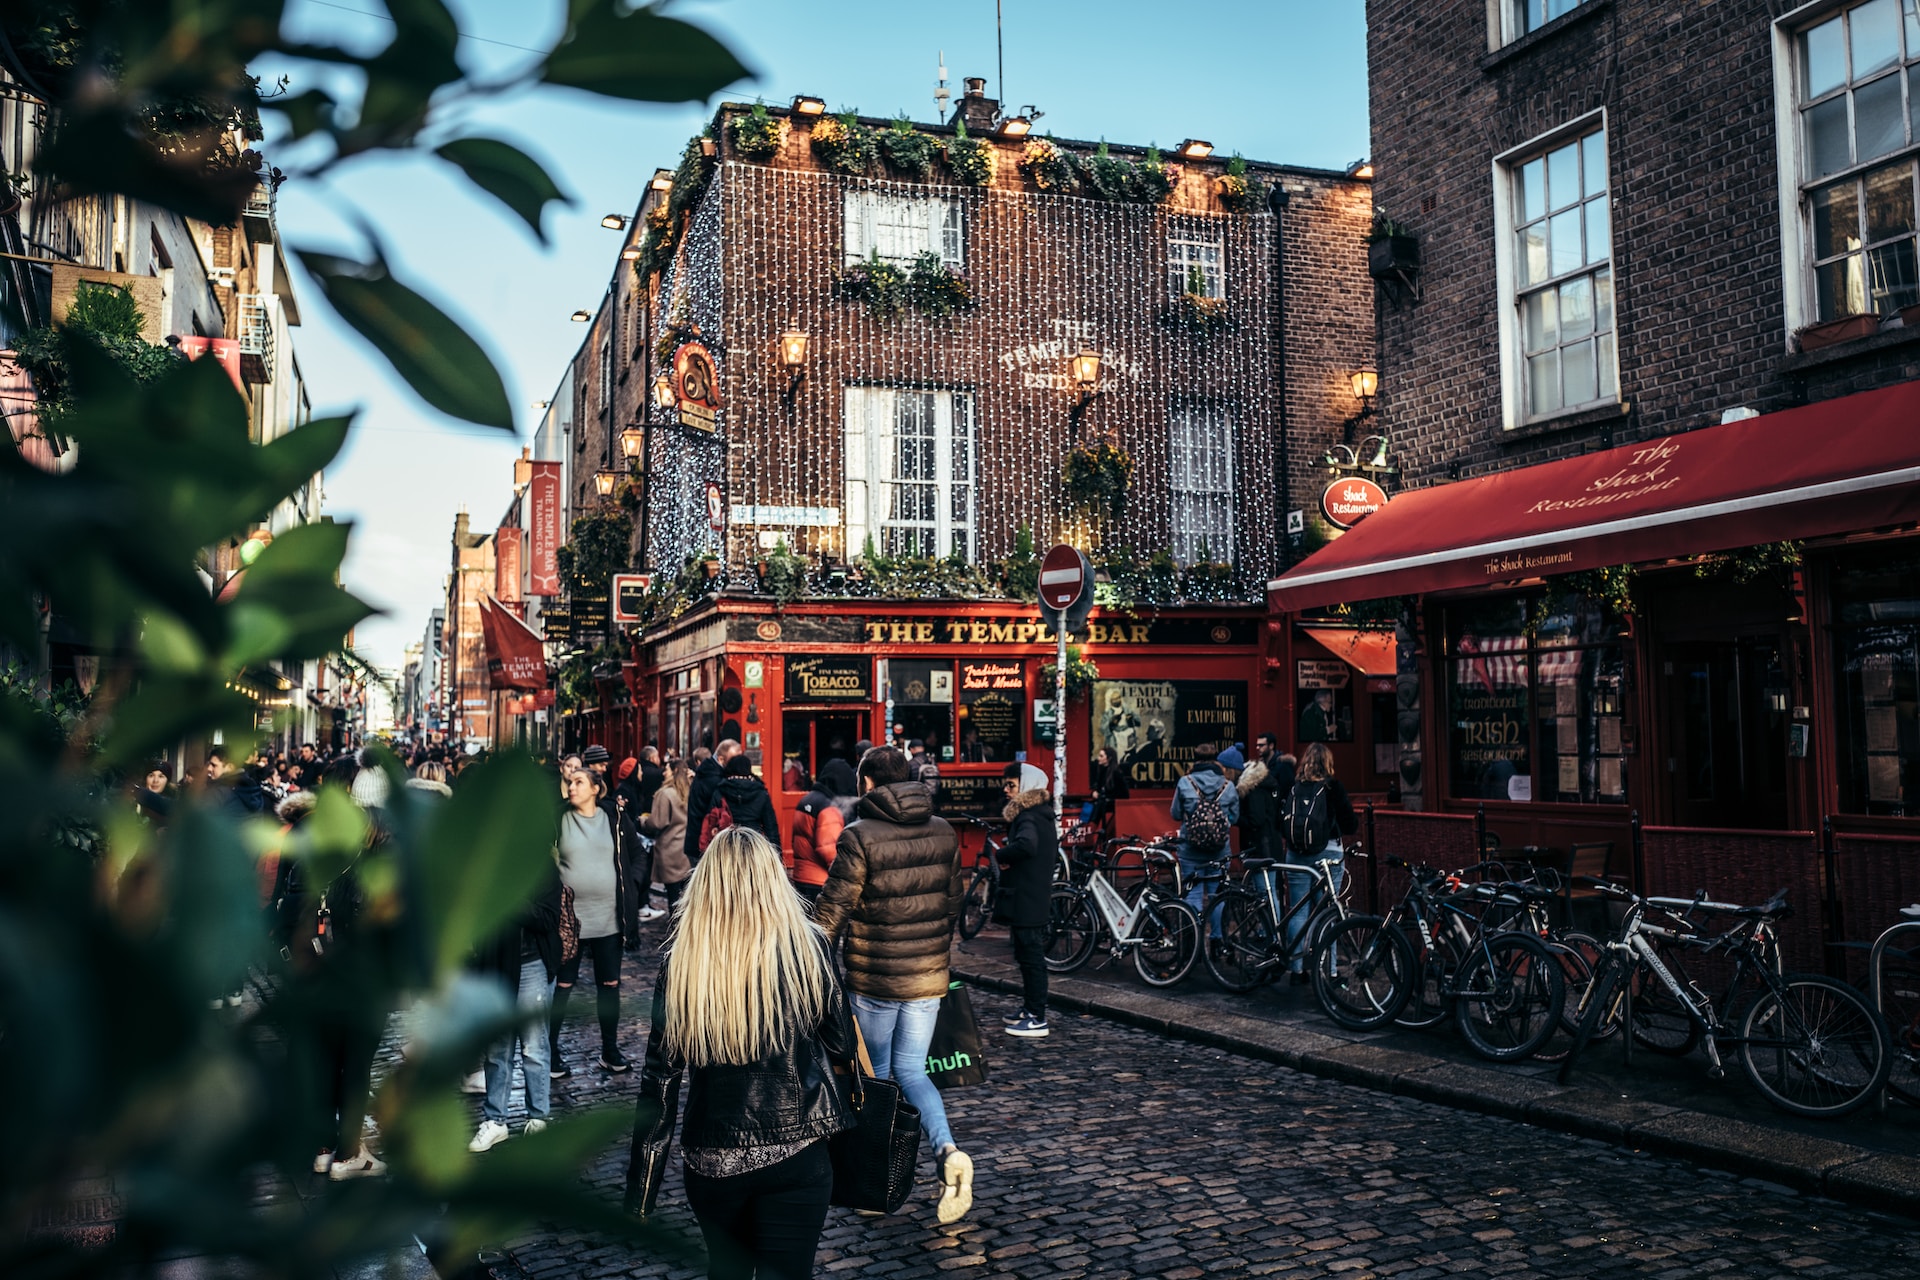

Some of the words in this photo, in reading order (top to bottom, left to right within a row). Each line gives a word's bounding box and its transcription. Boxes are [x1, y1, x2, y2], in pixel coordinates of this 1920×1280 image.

[1051, 319, 1097, 339] THE
[1628, 437, 1681, 466] The
[1585, 459, 1672, 492] Shack
[545, 483, 555, 505] THE
[1343, 485, 1368, 503] Shack
[1523, 476, 1681, 514] Restaurant
[1332, 502, 1379, 514] Restaurant
[535, 497, 543, 541] TRADING
[544, 506, 555, 549] TEMPLE
[544, 550, 555, 572] BAR
[1484, 558, 1499, 575] The
[1501, 553, 1523, 573] Shack
[1526, 551, 1574, 569] Restaurant
[865, 622, 935, 643] THE
[1088, 623, 1150, 643] BAR
[502, 662, 542, 672] TEMPLE
[512, 671, 534, 679] BAR
[964, 663, 1020, 677] Traditional
[798, 672, 860, 693] TOBACCO
[963, 676, 989, 689] Irish
[992, 676, 1023, 689] Music
[1120, 686, 1175, 698] TEMPLE
[1136, 698, 1161, 709] BAR
[1214, 695, 1236, 708] THE
[1187, 709, 1236, 723] EMPEROR
[1223, 725, 1236, 739] OF
[940, 779, 985, 789] TEMPLE
